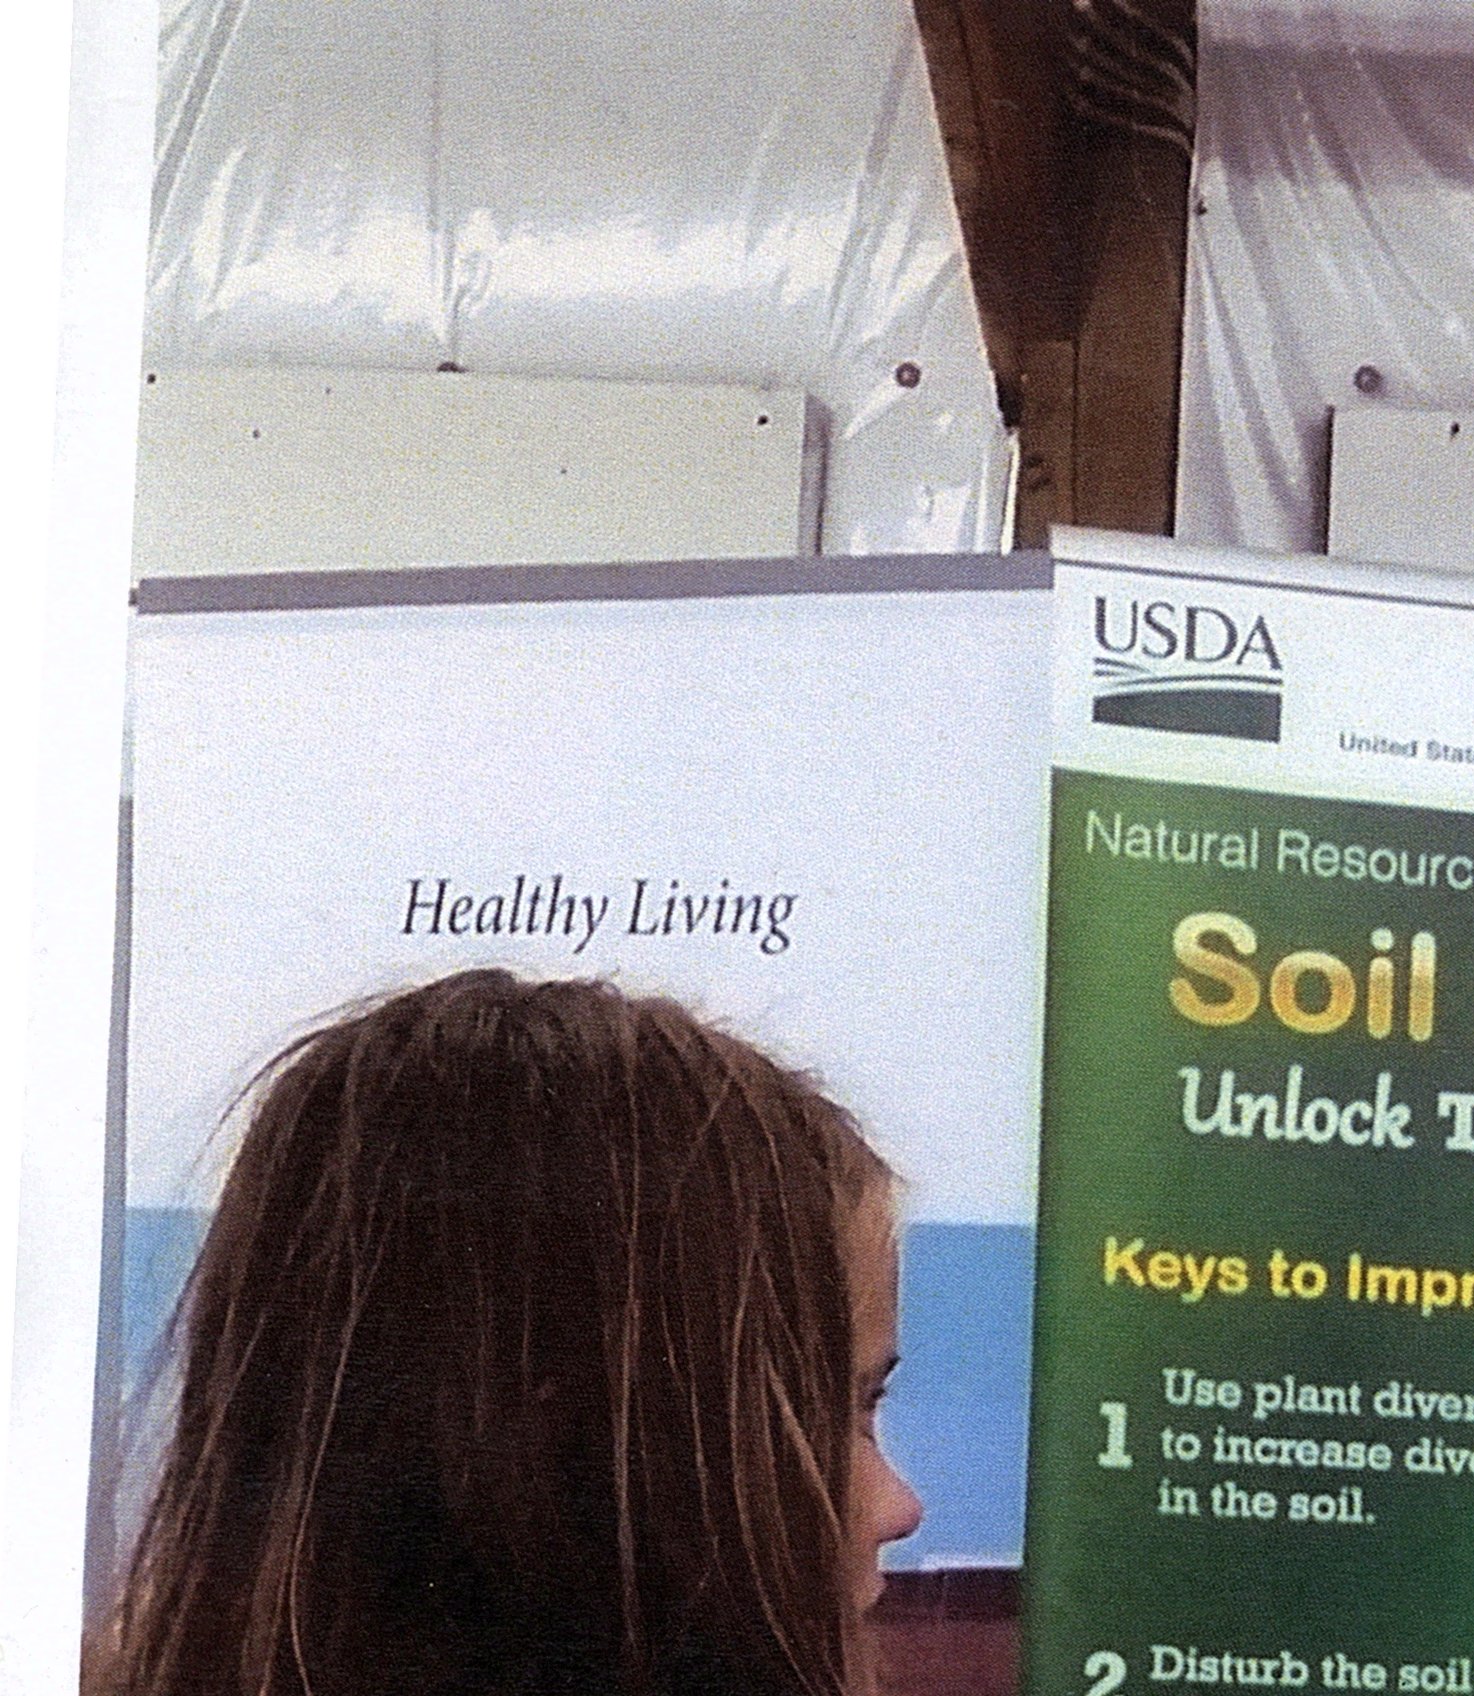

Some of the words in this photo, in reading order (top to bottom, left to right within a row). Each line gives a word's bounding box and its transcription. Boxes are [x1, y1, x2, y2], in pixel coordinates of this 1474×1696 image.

[1092, 596, 1283, 671] USDA
[1339, 733, 1418, 757] United
[1086, 810, 1258, 867] Natural
[403, 875, 608, 953] Healthy
[628, 880, 795, 954] Living
[1170, 912, 1435, 1040] Soil
[1180, 1066, 1413, 1147] Unlock
[1104, 1237, 1248, 1300] Keys
[1269, 1251, 1327, 1298] to
[1164, 1369, 1241, 1408] Use
[1254, 1376, 1361, 1419] plant
[1099, 1403, 1131, 1467] 1
[1162, 1428, 1201, 1460] to
[1214, 1427, 1392, 1470] increase
[1159, 1480, 1198, 1514] in
[1212, 1482, 1277, 1518] the
[1289, 1488, 1374, 1522] soil.
[1151, 1646, 1309, 1685] Disturb
[1322, 1653, 1387, 1689] the
[1399, 1659, 1471, 1692] soil
